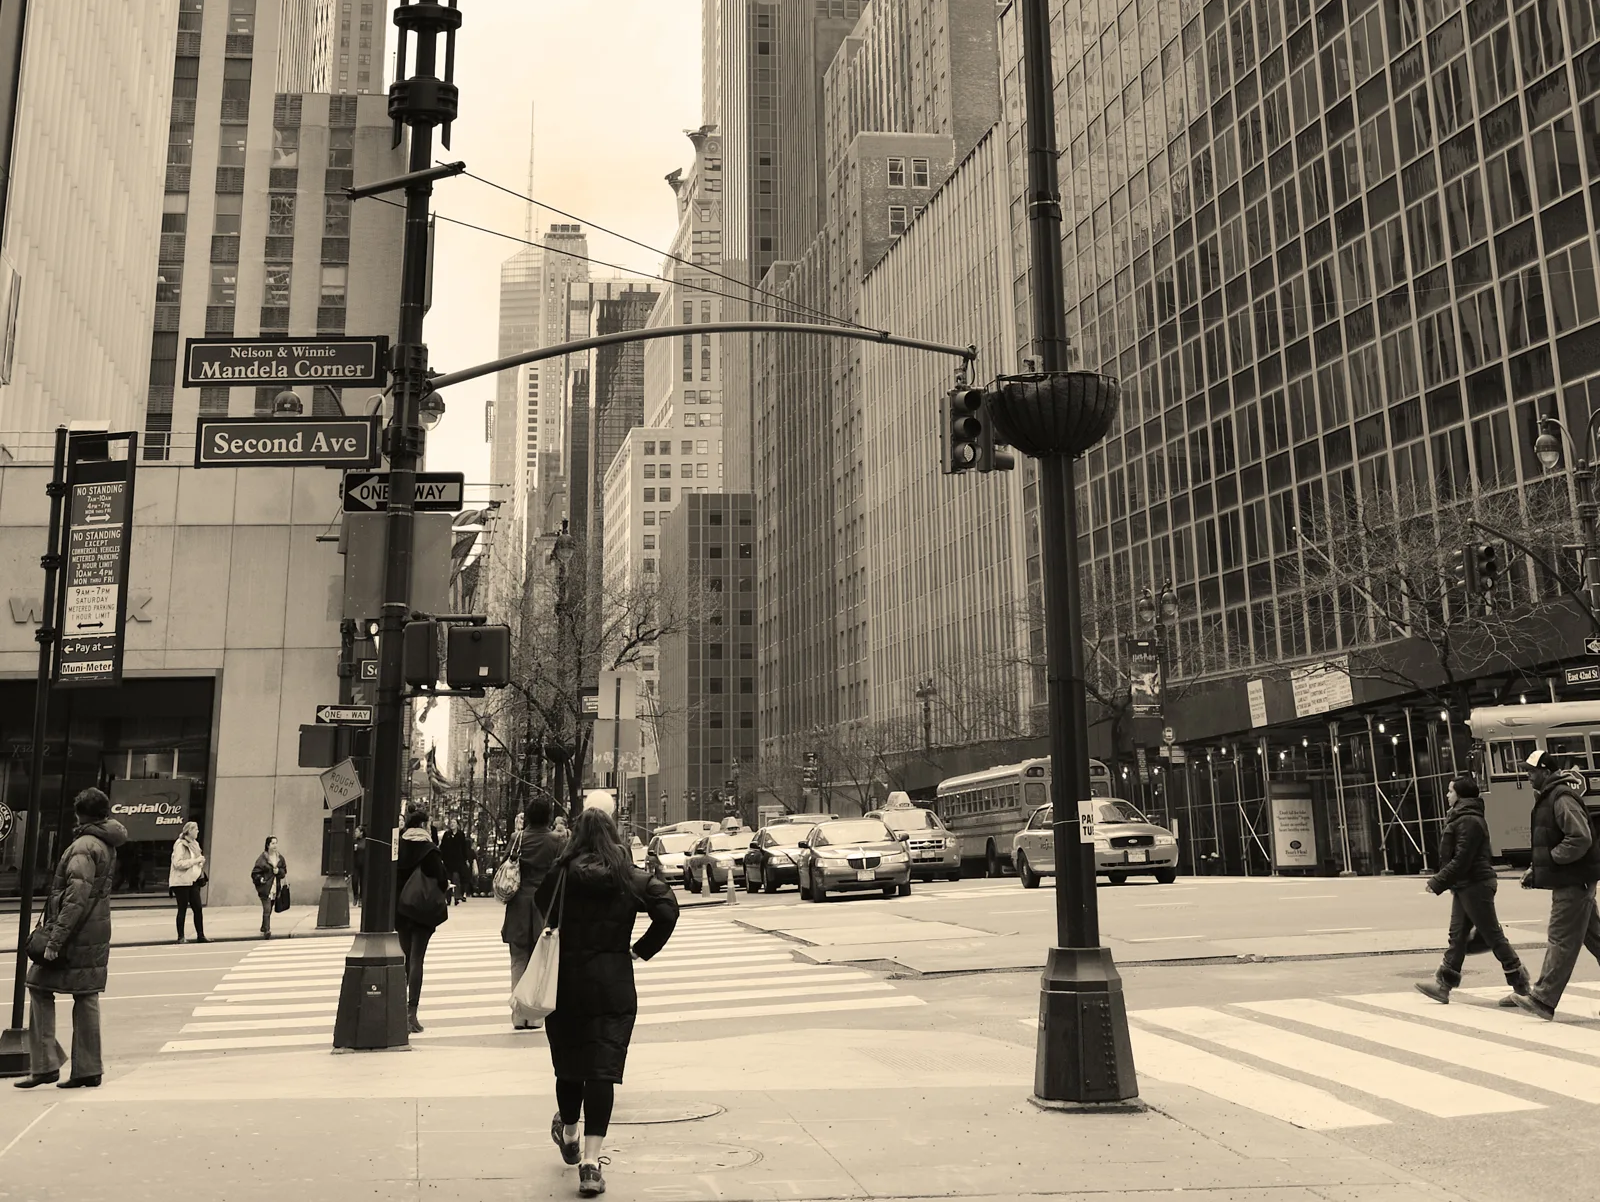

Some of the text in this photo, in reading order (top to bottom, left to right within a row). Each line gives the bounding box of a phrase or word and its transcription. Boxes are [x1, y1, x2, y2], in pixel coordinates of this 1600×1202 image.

[230, 346, 336, 358] Nelson & Winnie
[199, 360, 365, 379] Mandela Corner
[213, 431, 357, 454] Second Ave
[77, 484, 123, 496] NO STANDING
[360, 485, 389, 500] ONE
[73, 530, 121, 541] NO STANDING
[72, 553, 119, 563] METERED PARKING
[75, 596, 109, 604] SATURDAY
[68, 603, 115, 613] METERED PARKING
[95, 611, 110, 620] LIMIT
[75, 642, 102, 654] Pay at
[62, 663, 111, 673] Muni-Meter
[1567, 673, 1580, 682] East
[1591, 669, 1599, 679] St
[324, 710, 369, 719] ONE WAY
[330, 772, 355, 788] ROUGH
[329, 783, 349, 797] ROAD
[155, 816, 184, 825] Bank
